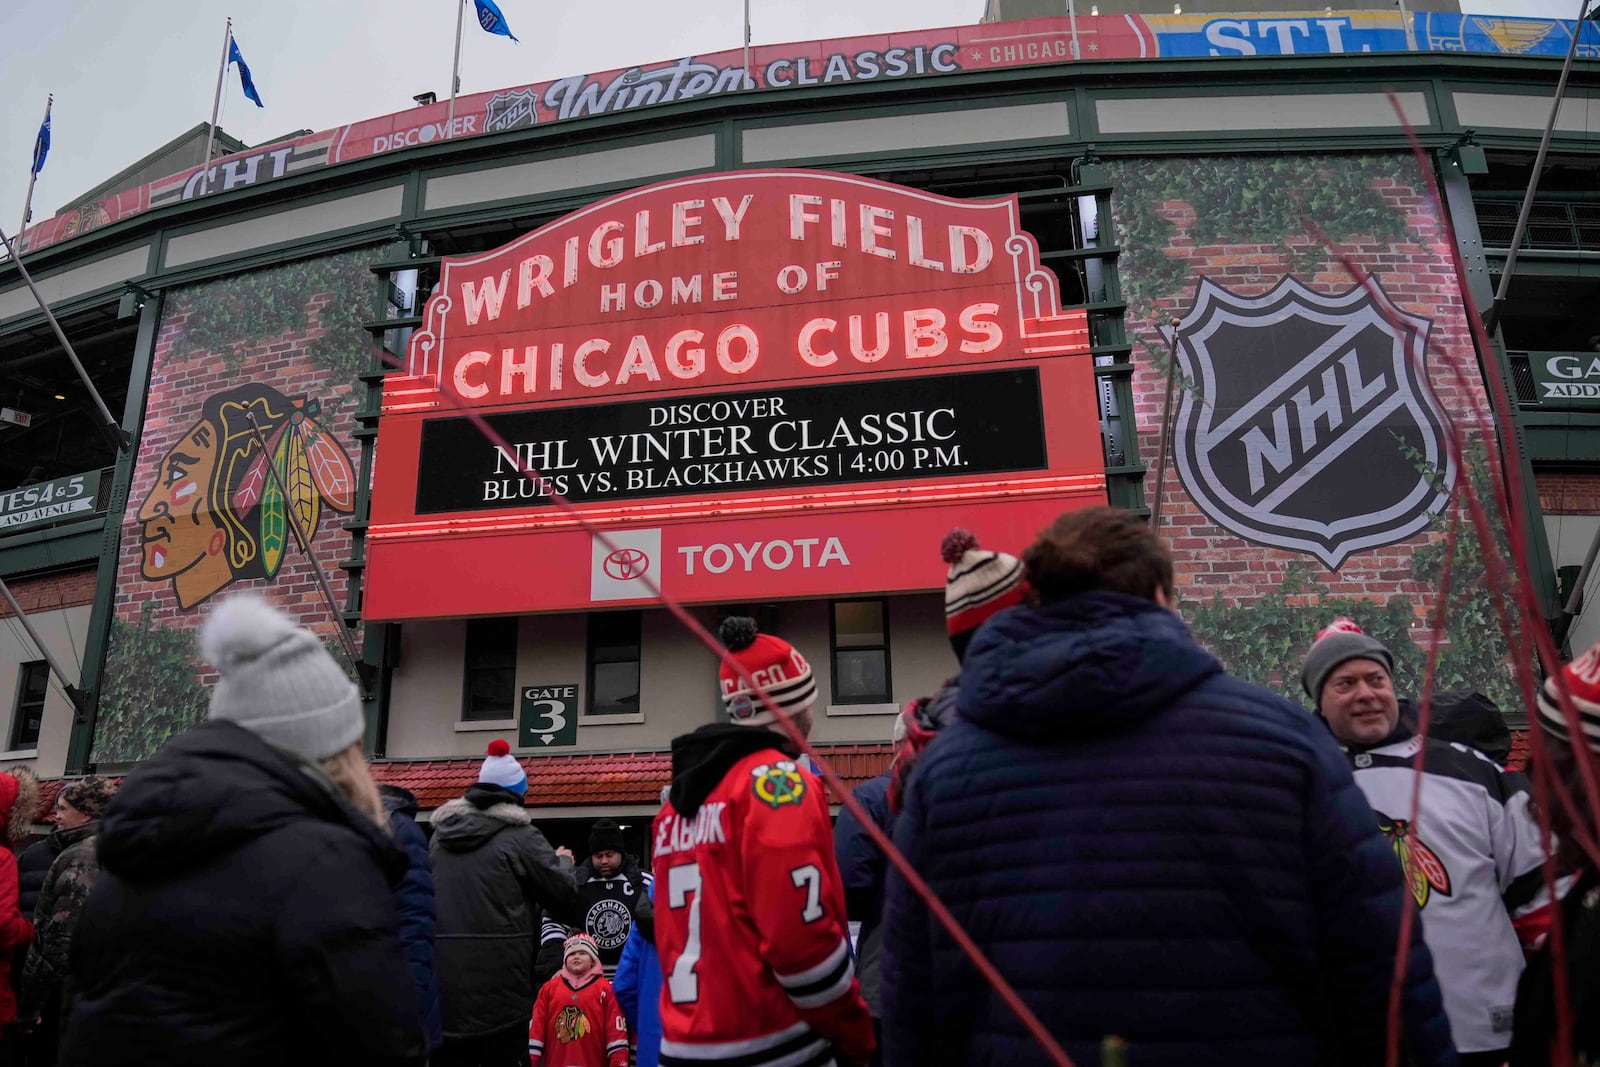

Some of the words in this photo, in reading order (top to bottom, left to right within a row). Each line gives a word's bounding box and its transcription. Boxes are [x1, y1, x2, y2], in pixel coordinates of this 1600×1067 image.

[1206, 19, 1371, 57] STL
[544, 56, 757, 121] Winter
[766, 44, 958, 87] CLASSIC
[373, 115, 477, 154] DISCOVER
[495, 102, 530, 131] NHL
[182, 147, 292, 200] CHI
[460, 194, 754, 326] WRIGLEY
[790, 193, 994, 274] FIELD
[600, 271, 738, 313] HOME
[776, 260, 842, 294] OF
[452, 323, 760, 399] CHICAGO
[798, 302, 1003, 368] CUBS
[649, 396, 788, 427] DISCOVER
[1238, 347, 1388, 497] NHL
[493, 439, 579, 475] NHL
[588, 425, 758, 467] WINTER
[768, 407, 957, 453] CLASSIC
[482, 475, 569, 501] BLUES
[577, 471, 618, 494] VS.
[626, 454, 830, 490] BLACKHAWKS
[850, 449, 905, 473] 4:00
[912, 445, 969, 470] P.M.
[31, 501, 75, 519] AVENUE
[677, 536, 851, 575] TOYOTA
[525, 686, 575, 700] GATE
[529, 699, 567, 734] 3
[623, 881, 634, 896] C
[790, 864, 824, 923] 7
[587, 901, 631, 926] BLACKHAWKS
[667, 862, 702, 1004] 7
[591, 932, 627, 948] CHICAGO
